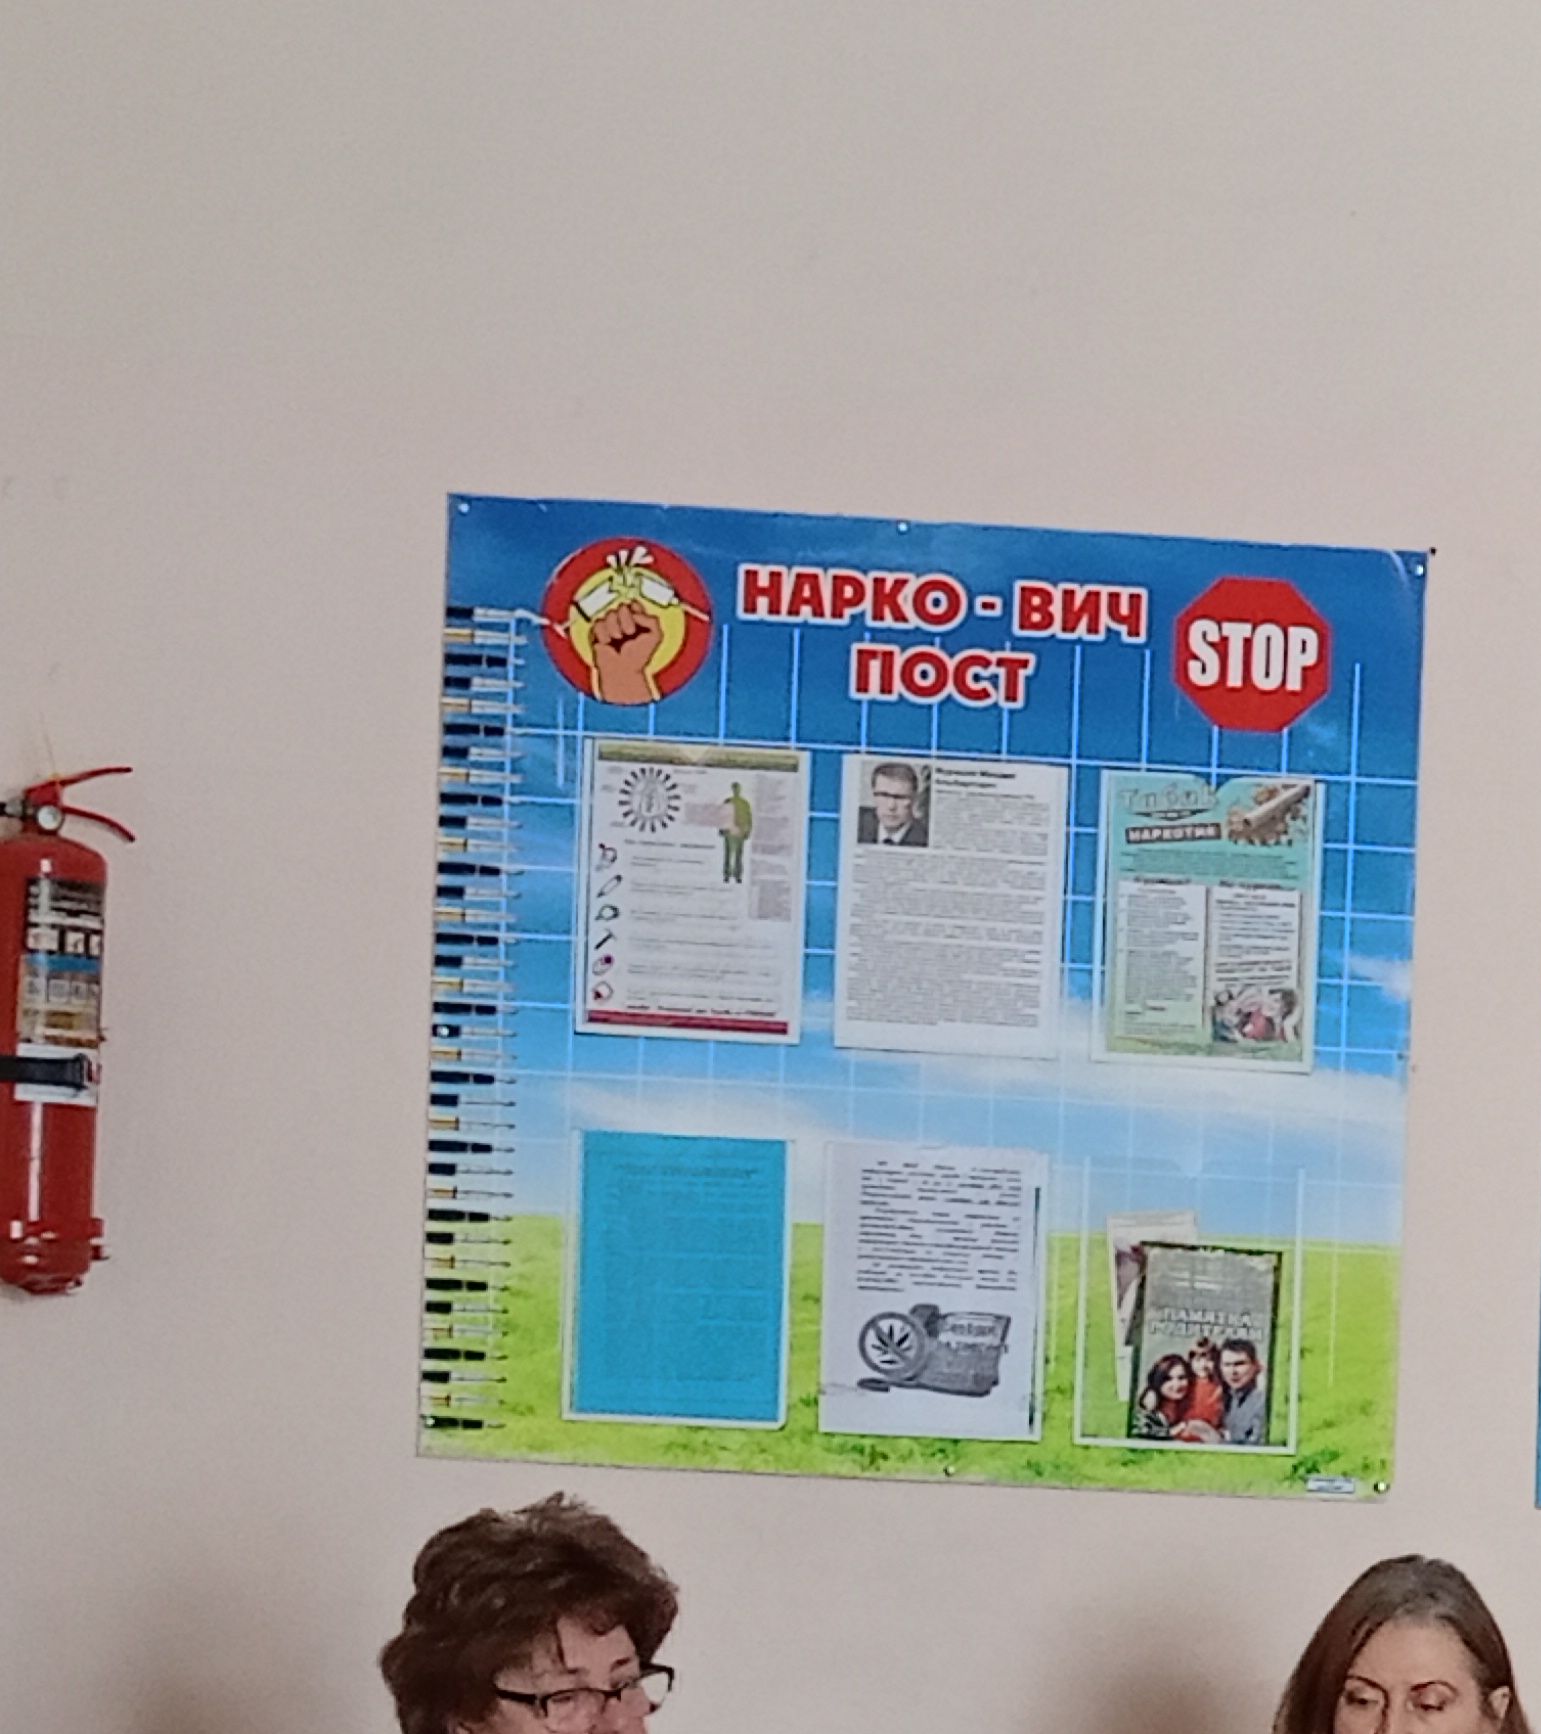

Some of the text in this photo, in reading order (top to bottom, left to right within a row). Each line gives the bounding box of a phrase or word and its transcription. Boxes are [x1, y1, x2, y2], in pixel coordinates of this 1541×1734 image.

[740, 566, 963, 627] НАРКО
[1015, 583, 1145, 641] ВИЧ
[853, 644, 1033, 705] ПОСТ
[1188, 619, 1319, 692] STOP
